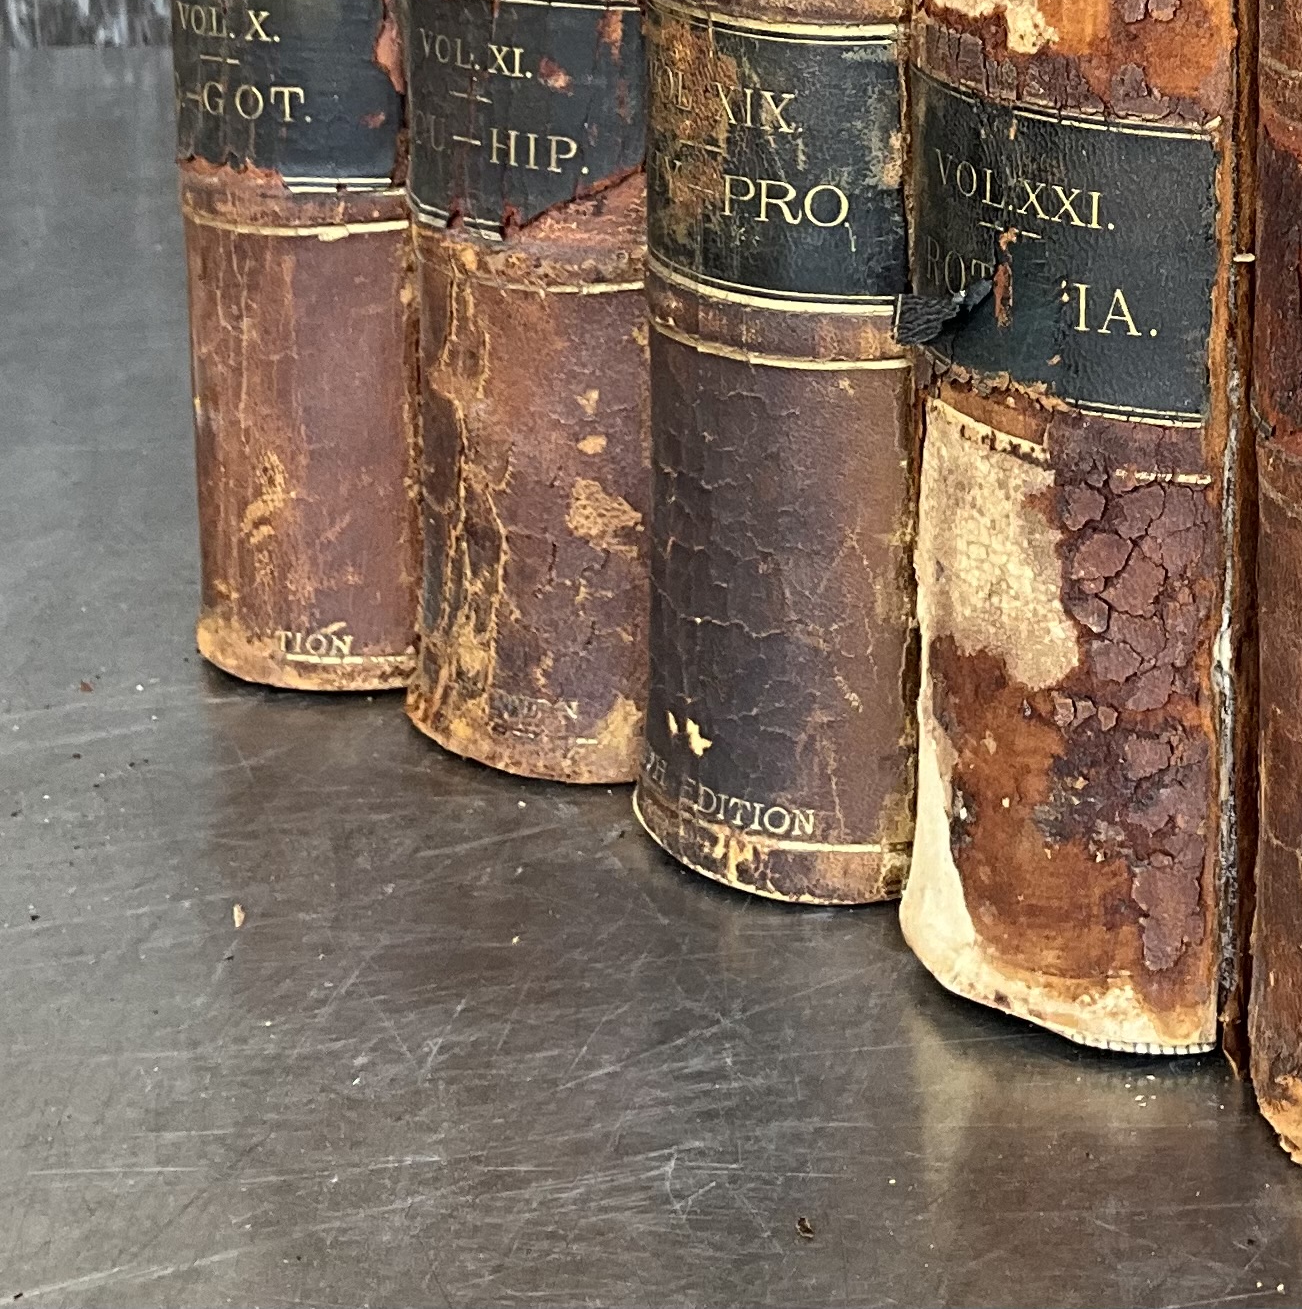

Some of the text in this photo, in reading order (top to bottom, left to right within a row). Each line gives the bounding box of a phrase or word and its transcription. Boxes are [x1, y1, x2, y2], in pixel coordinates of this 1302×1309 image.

[176, 0, 281, 43] VOL. X.
[419, 27, 533, 79] VOL. XI.
